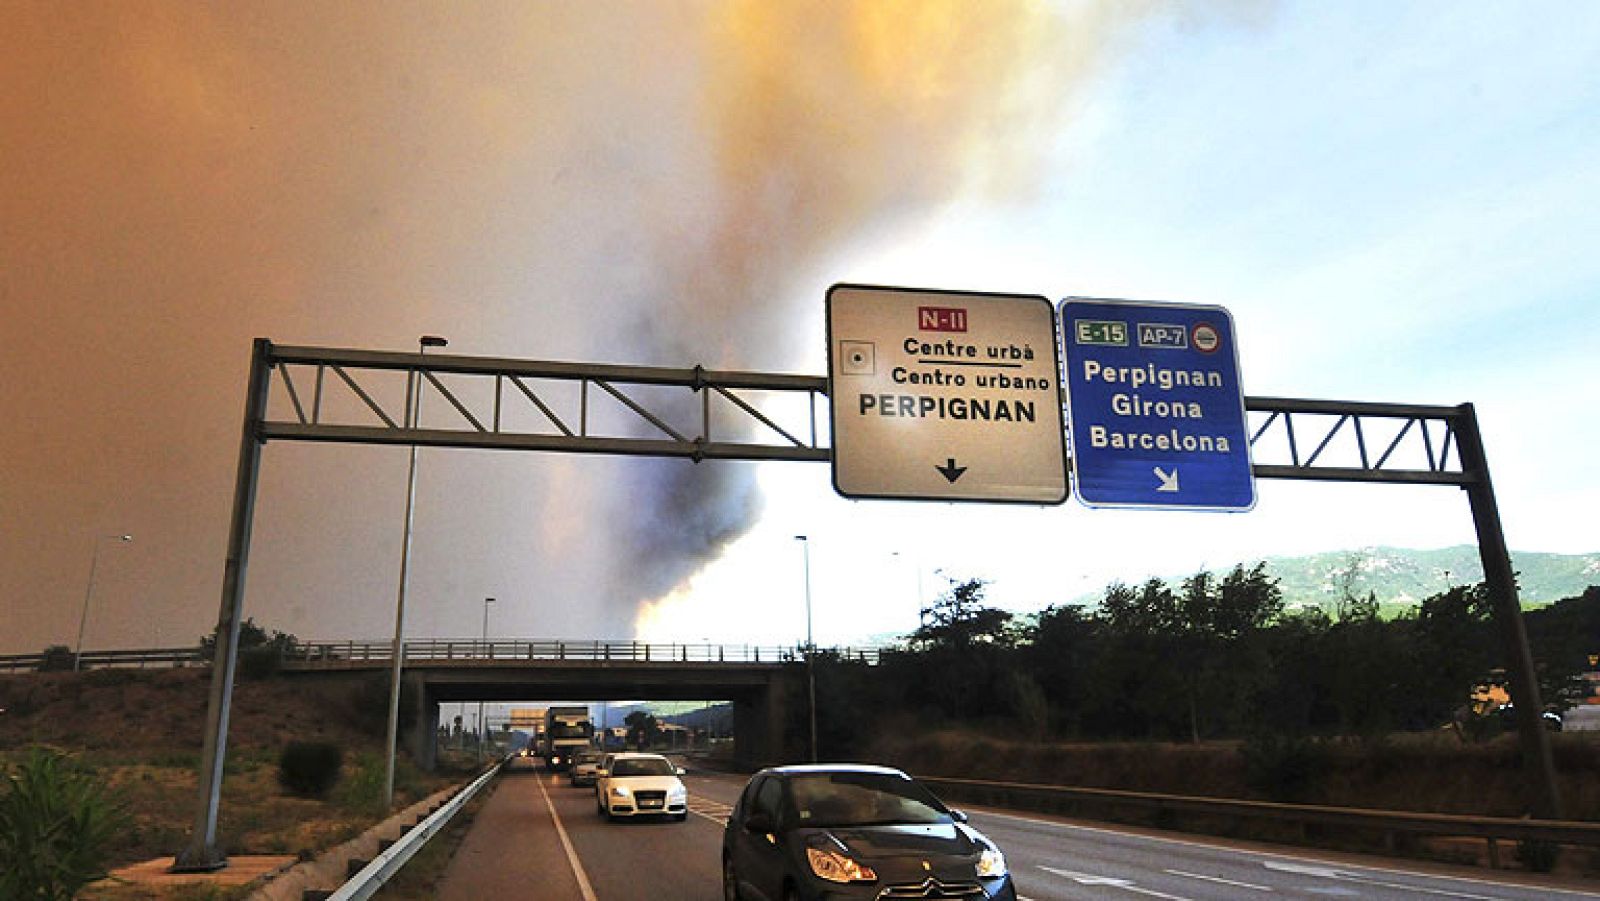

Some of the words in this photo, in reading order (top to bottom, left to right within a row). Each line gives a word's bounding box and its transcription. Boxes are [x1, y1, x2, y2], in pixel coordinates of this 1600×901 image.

[922, 308, 965, 331] N-II
[1078, 323, 1124, 343] E-15
[1142, 327, 1183, 346] AP-7
[903, 338, 977, 358] Centre
[987, 343, 1035, 360] urbà
[892, 367, 966, 387] Centro
[976, 373, 1049, 390] urbano
[1084, 361, 1222, 388] Perpignan
[860, 394, 1036, 422] PERPIGNAN
[1112, 394, 1202, 418] Girona
[1090, 426, 1230, 452] Barcelona
